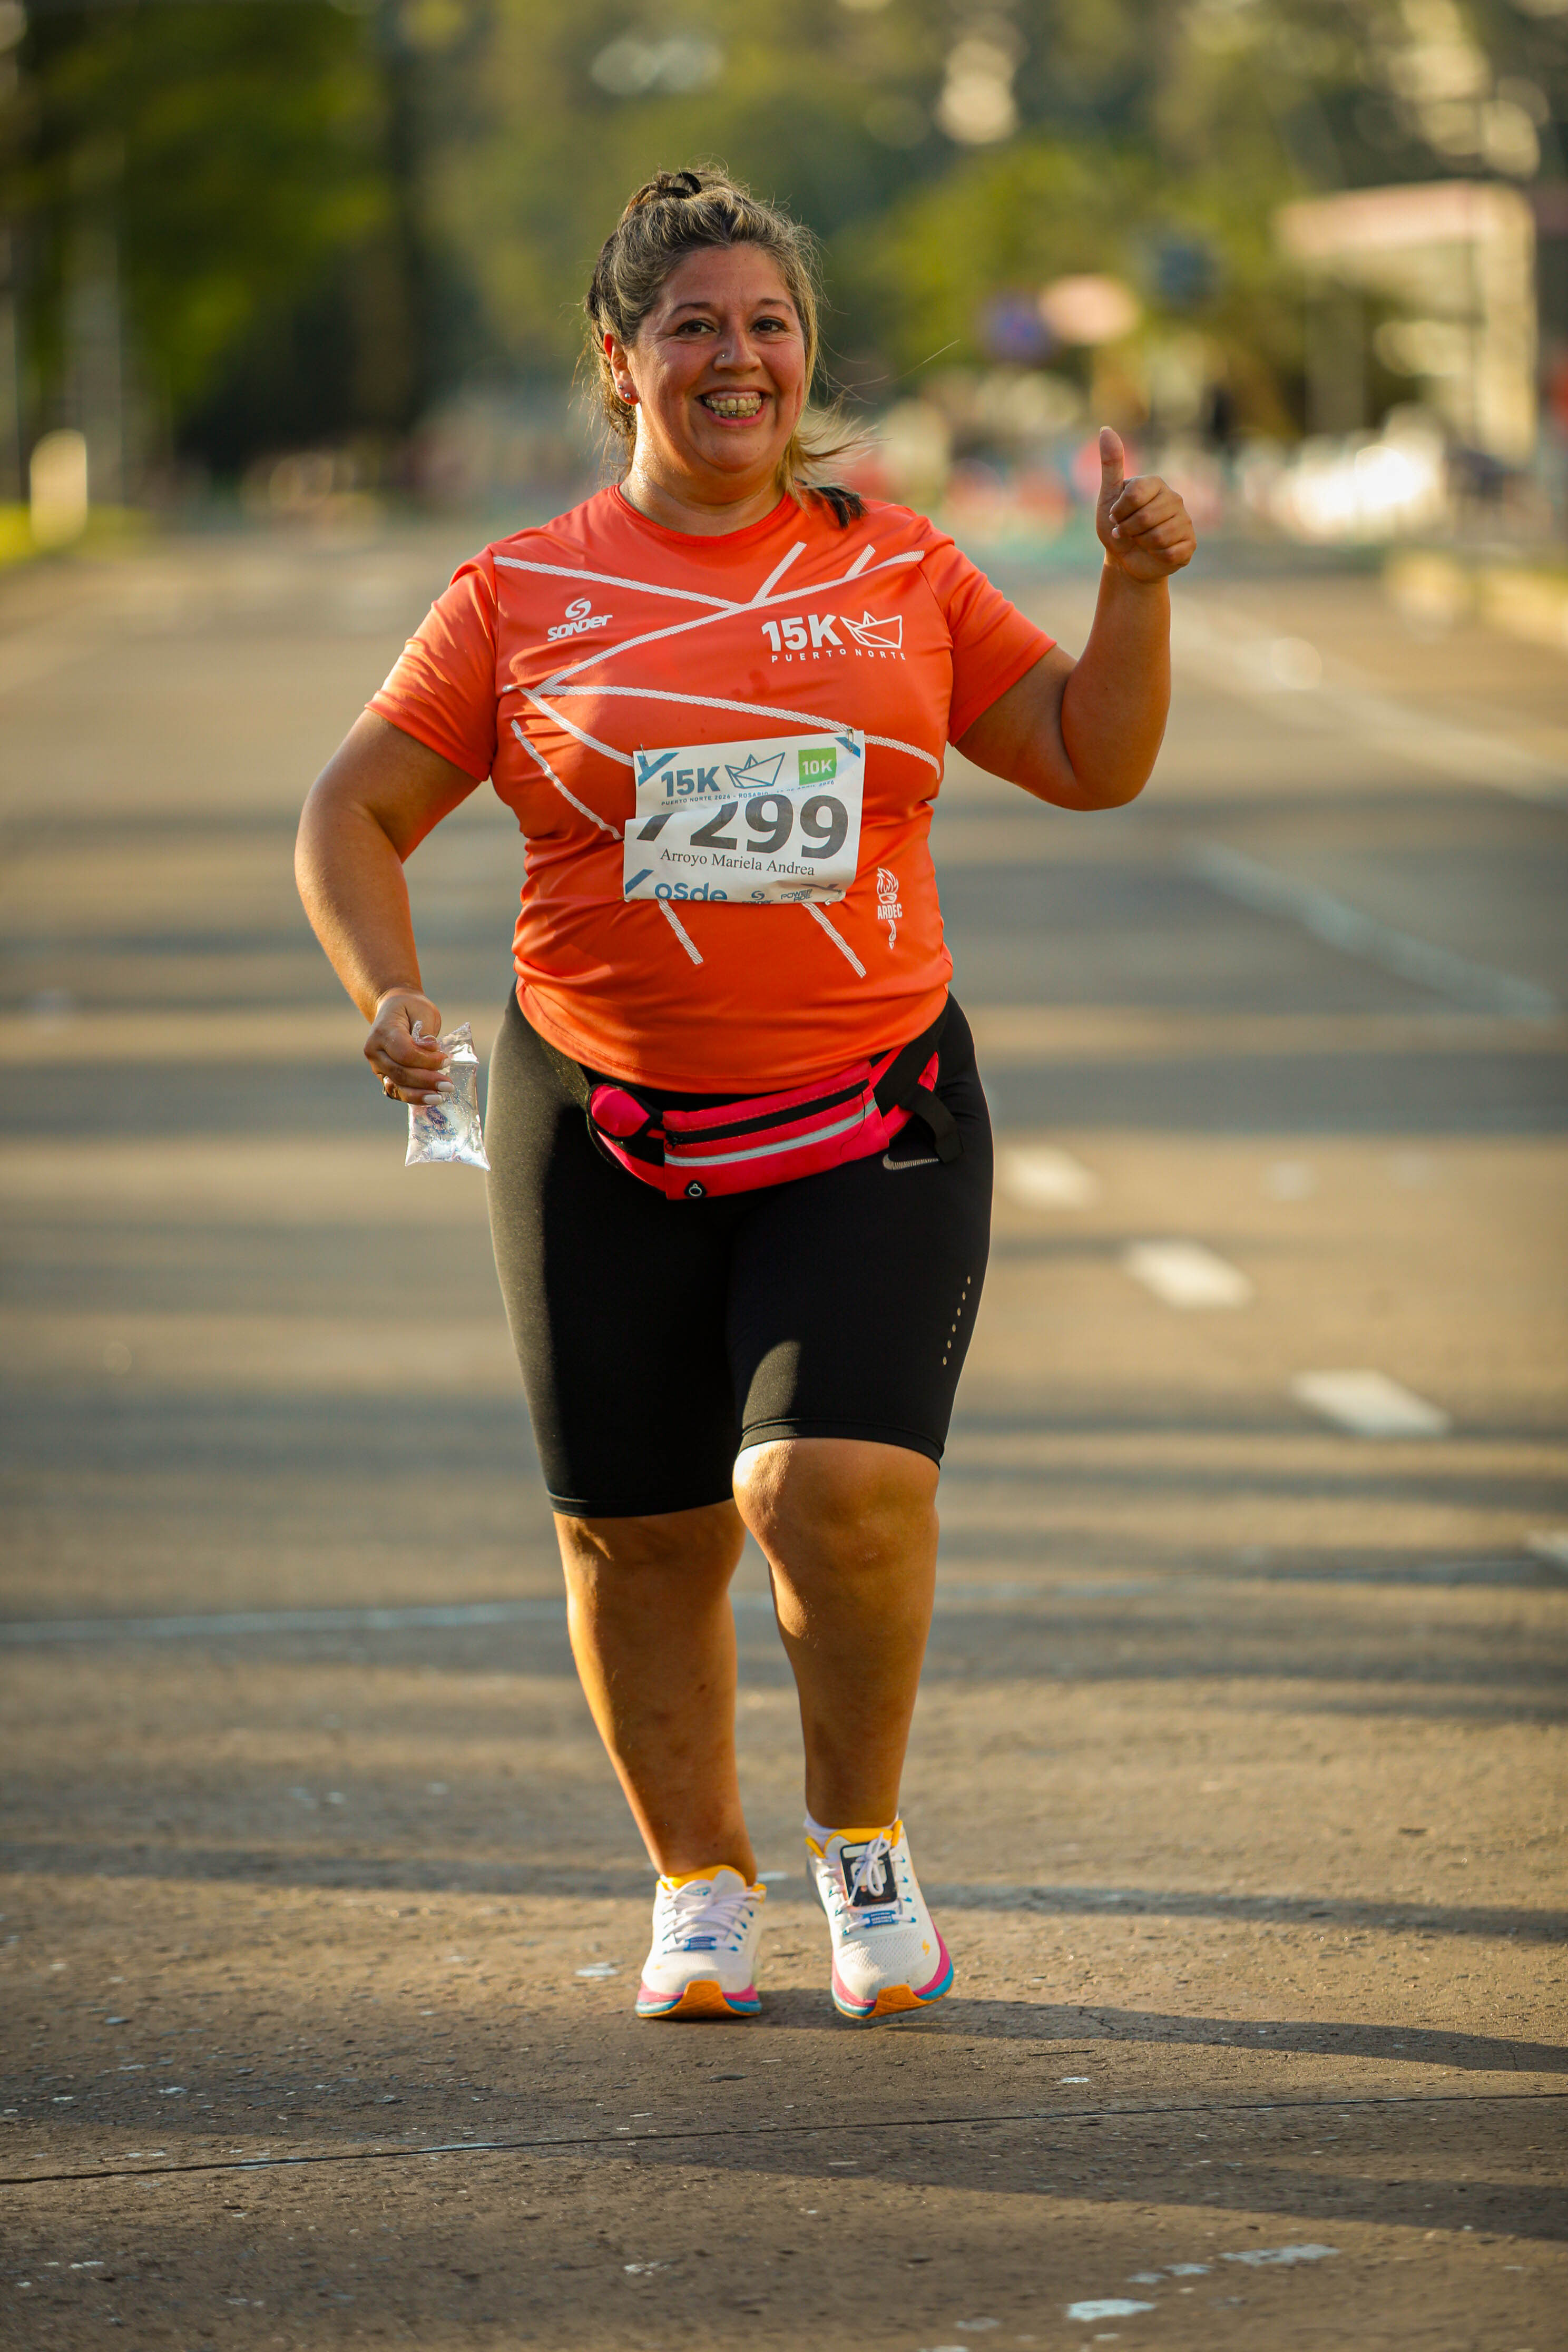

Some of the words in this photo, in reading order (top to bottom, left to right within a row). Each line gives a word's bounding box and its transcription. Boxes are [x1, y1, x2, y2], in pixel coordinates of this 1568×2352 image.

[761, 614, 843, 652] 15K
[771, 649, 846, 663] PUERTO
[855, 649, 906, 661] NORTE
[802, 759, 832, 775] 10K
[661, 766, 720, 797] 15K
[660, 848, 707, 866] Arroyo
[711, 853, 762, 870] Mariela
[766, 860, 815, 876] Andrea
[654, 882, 728, 901] osde
[877, 903, 903, 919] ARDEC
